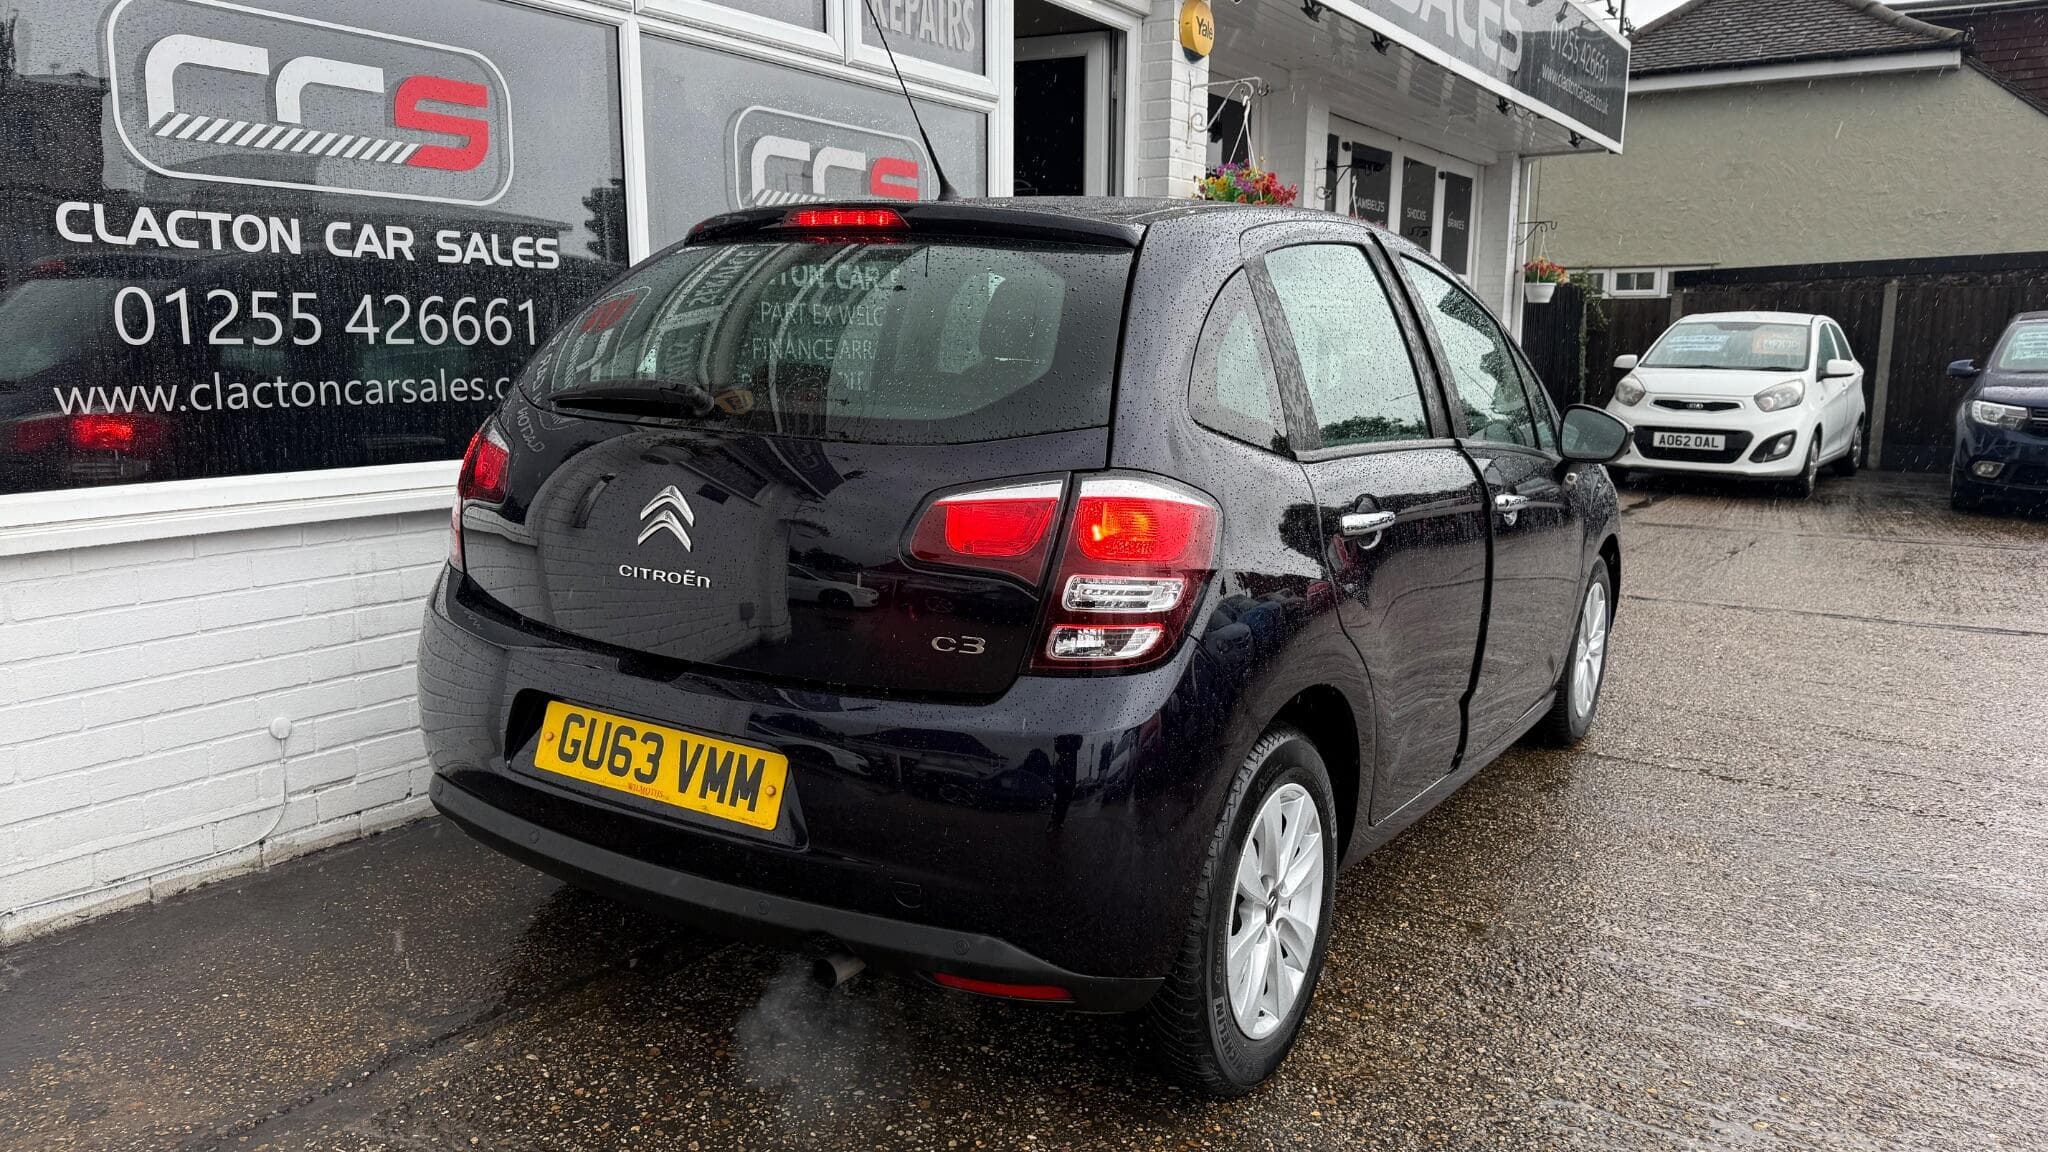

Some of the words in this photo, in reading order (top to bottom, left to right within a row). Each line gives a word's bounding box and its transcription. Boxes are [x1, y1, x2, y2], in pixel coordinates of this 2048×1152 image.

[1196, 16, 1213, 40] Yale
[1385, 0, 1522, 71] LES
[1551, 20, 1579, 64] 01255
[1581, 41, 1609, 84] 426661
[56, 202, 301, 254] CLACTON
[325, 221, 415, 261] CAR
[436, 229, 560, 269] SALES
[1407, 208, 1427, 221] SHOCKS
[114, 287, 322, 346] 01255
[345, 294, 536, 346] 426661
[813, 303, 833, 325] EX
[752, 337, 833, 360] FINANCE
[53, 368, 510, 415] www.clactoncarsales.c
[931, 635, 986, 654] C3
[557, 712, 665, 785] GU63
[677, 739, 766, 812] VMM
